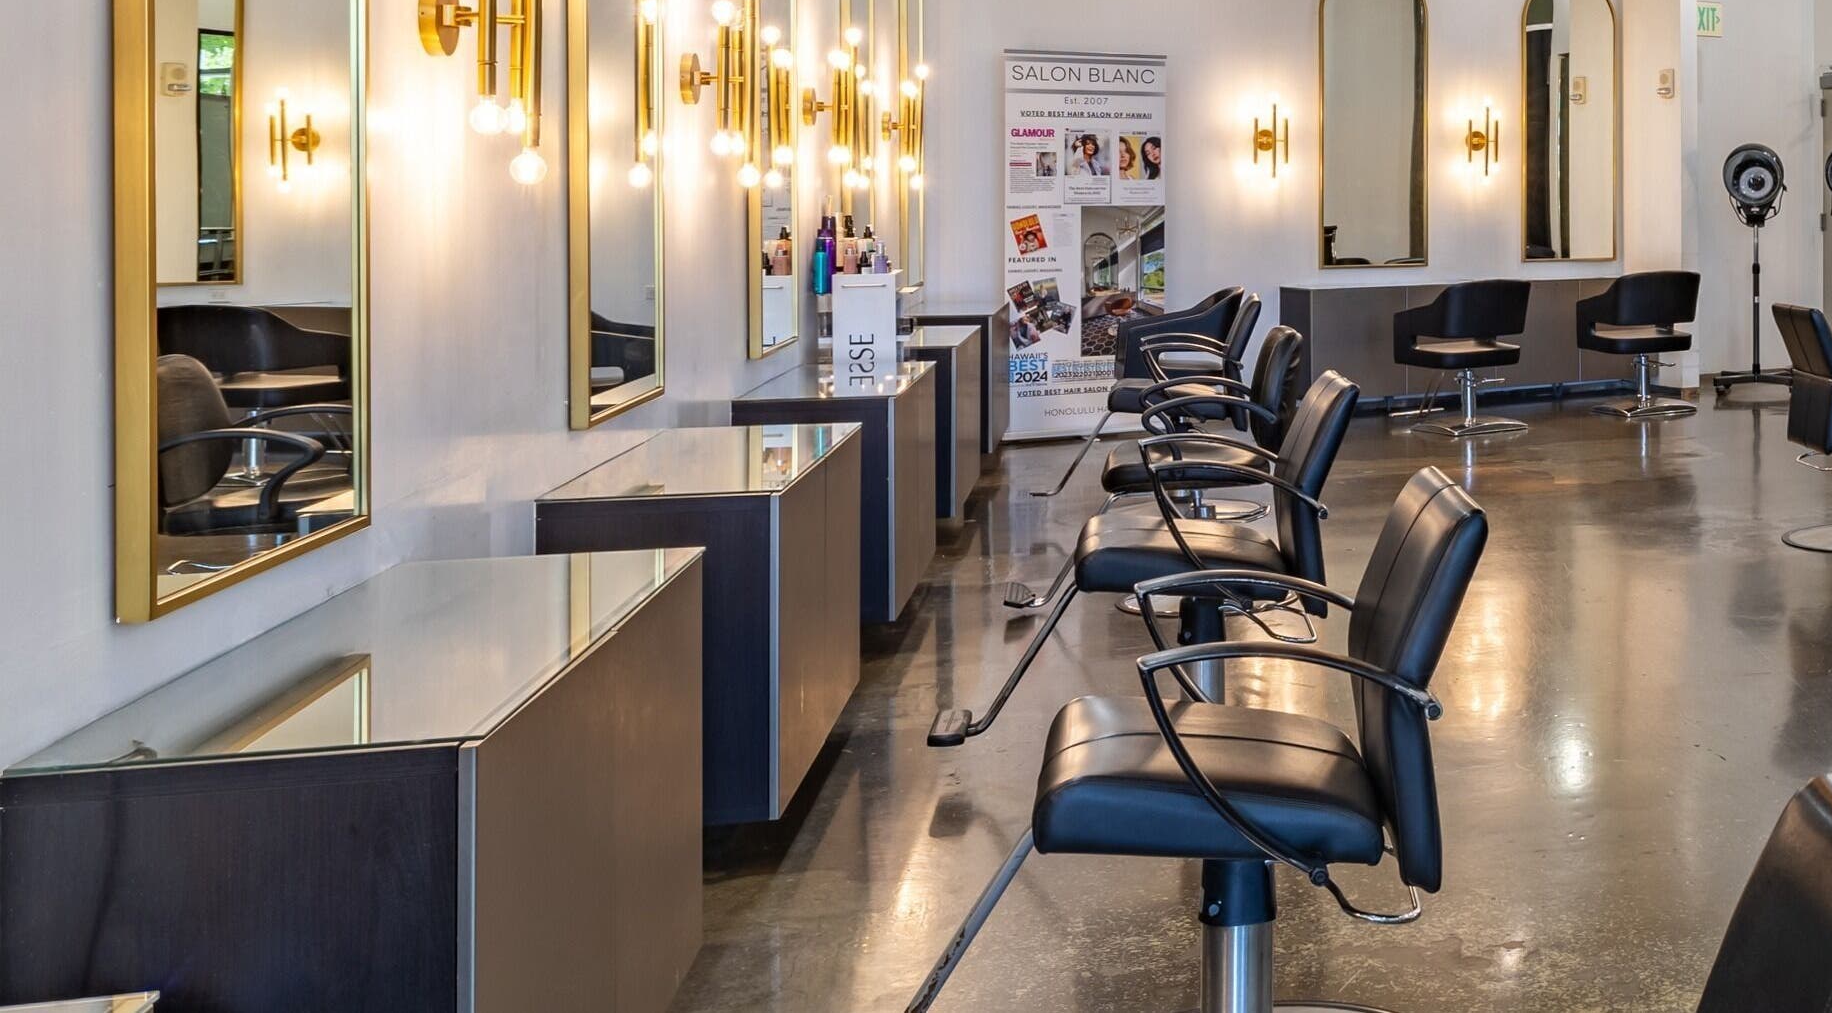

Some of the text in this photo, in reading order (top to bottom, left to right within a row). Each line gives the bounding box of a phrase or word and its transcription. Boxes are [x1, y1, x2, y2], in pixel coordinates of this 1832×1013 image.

[1697, 7, 1717, 31] XIT
[1012, 65, 1155, 84] SALON BLANC
[1064, 97, 1108, 106] Est. 2007
[1020, 110, 1045, 118] VOTED
[1047, 110, 1065, 118] BEST
[1087, 111, 1111, 119] SALON
[1011, 128, 1055, 138] GLAMOUR
[1008, 359, 1048, 371] BEST
[1015, 371, 1048, 383] 2024
[1063, 387, 1081, 395] HAIR
[1044, 407, 1095, 417] HONOLULU
